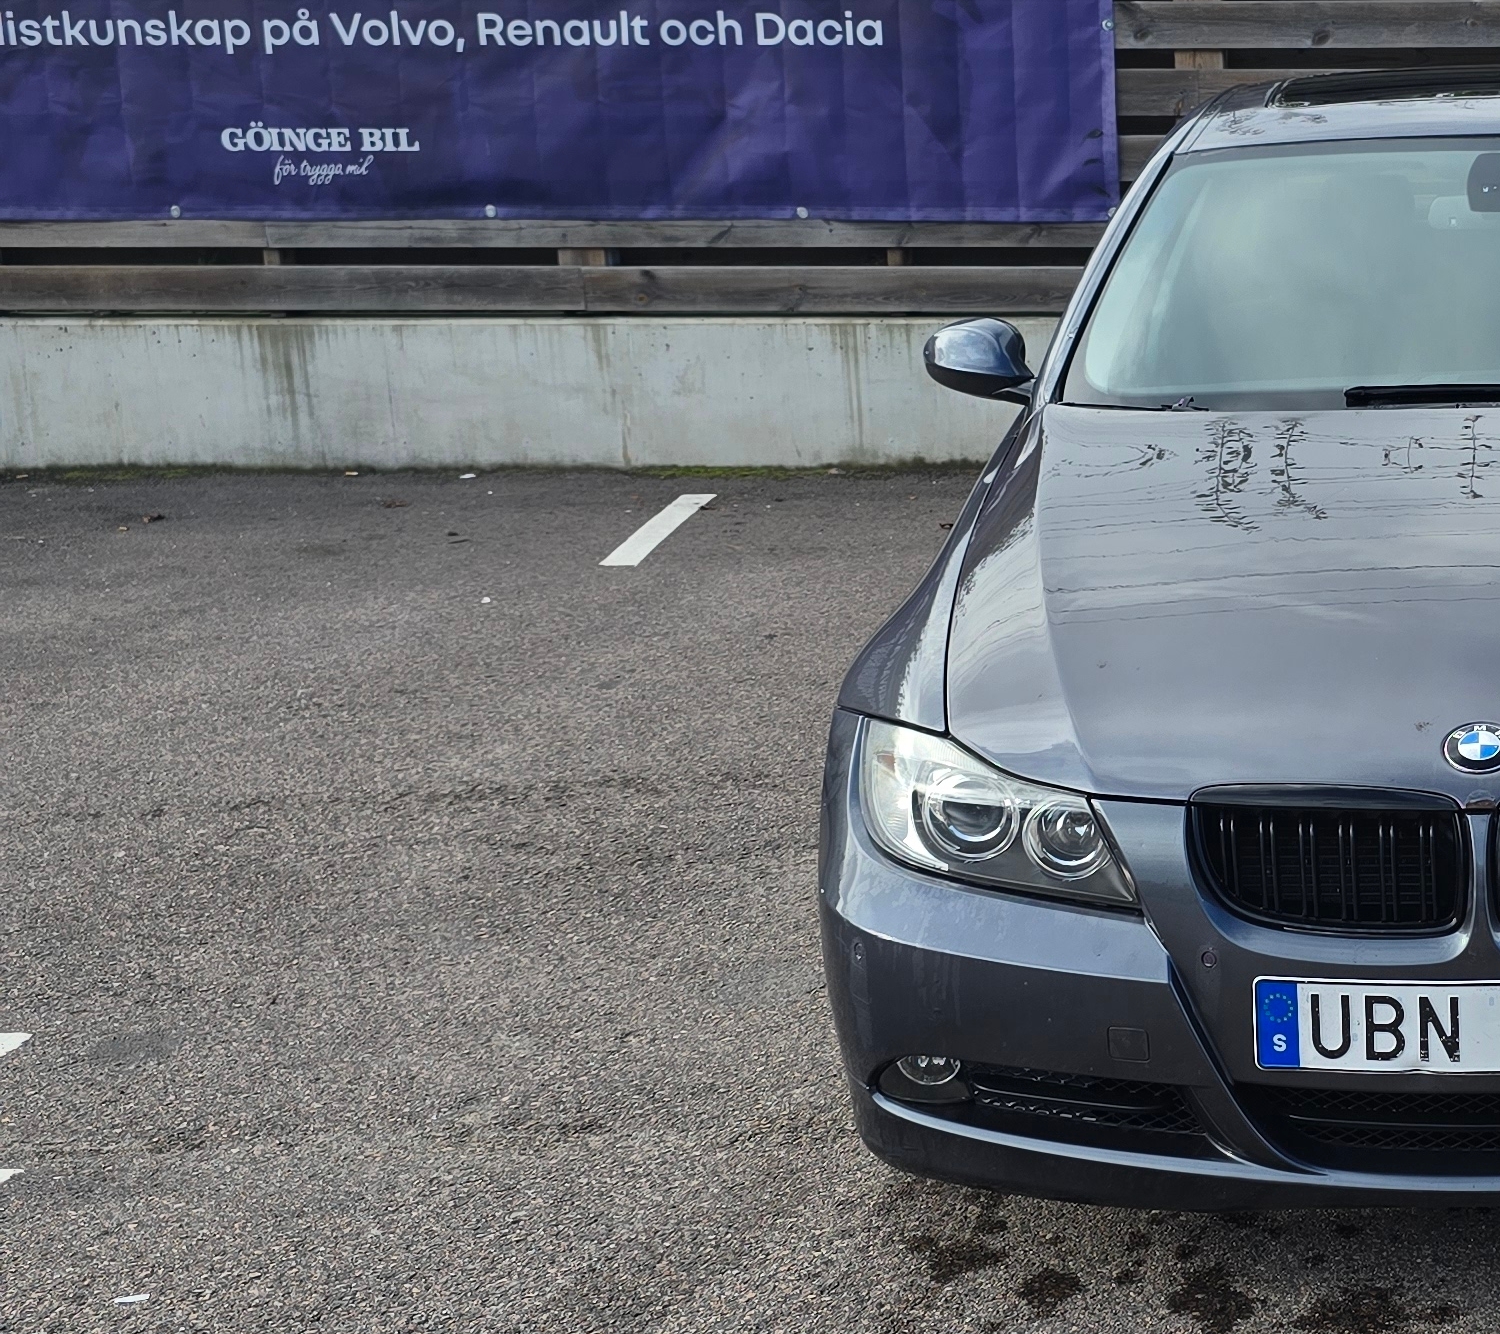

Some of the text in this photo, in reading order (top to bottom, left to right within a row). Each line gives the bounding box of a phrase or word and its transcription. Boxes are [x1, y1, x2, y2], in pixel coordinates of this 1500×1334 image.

[262, 8, 320, 55] på
[328, 10, 465, 53] Volvo,
[476, 10, 650, 47] Renault
[659, 10, 743, 46] och
[755, 10, 883, 46] Dacia
[220, 121, 420, 152] GÖINGE BIL
[274, 155, 374, 185] för trygga mil
[1272, 1034, 1287, 1052] S
[1310, 993, 1461, 1062] UBN
